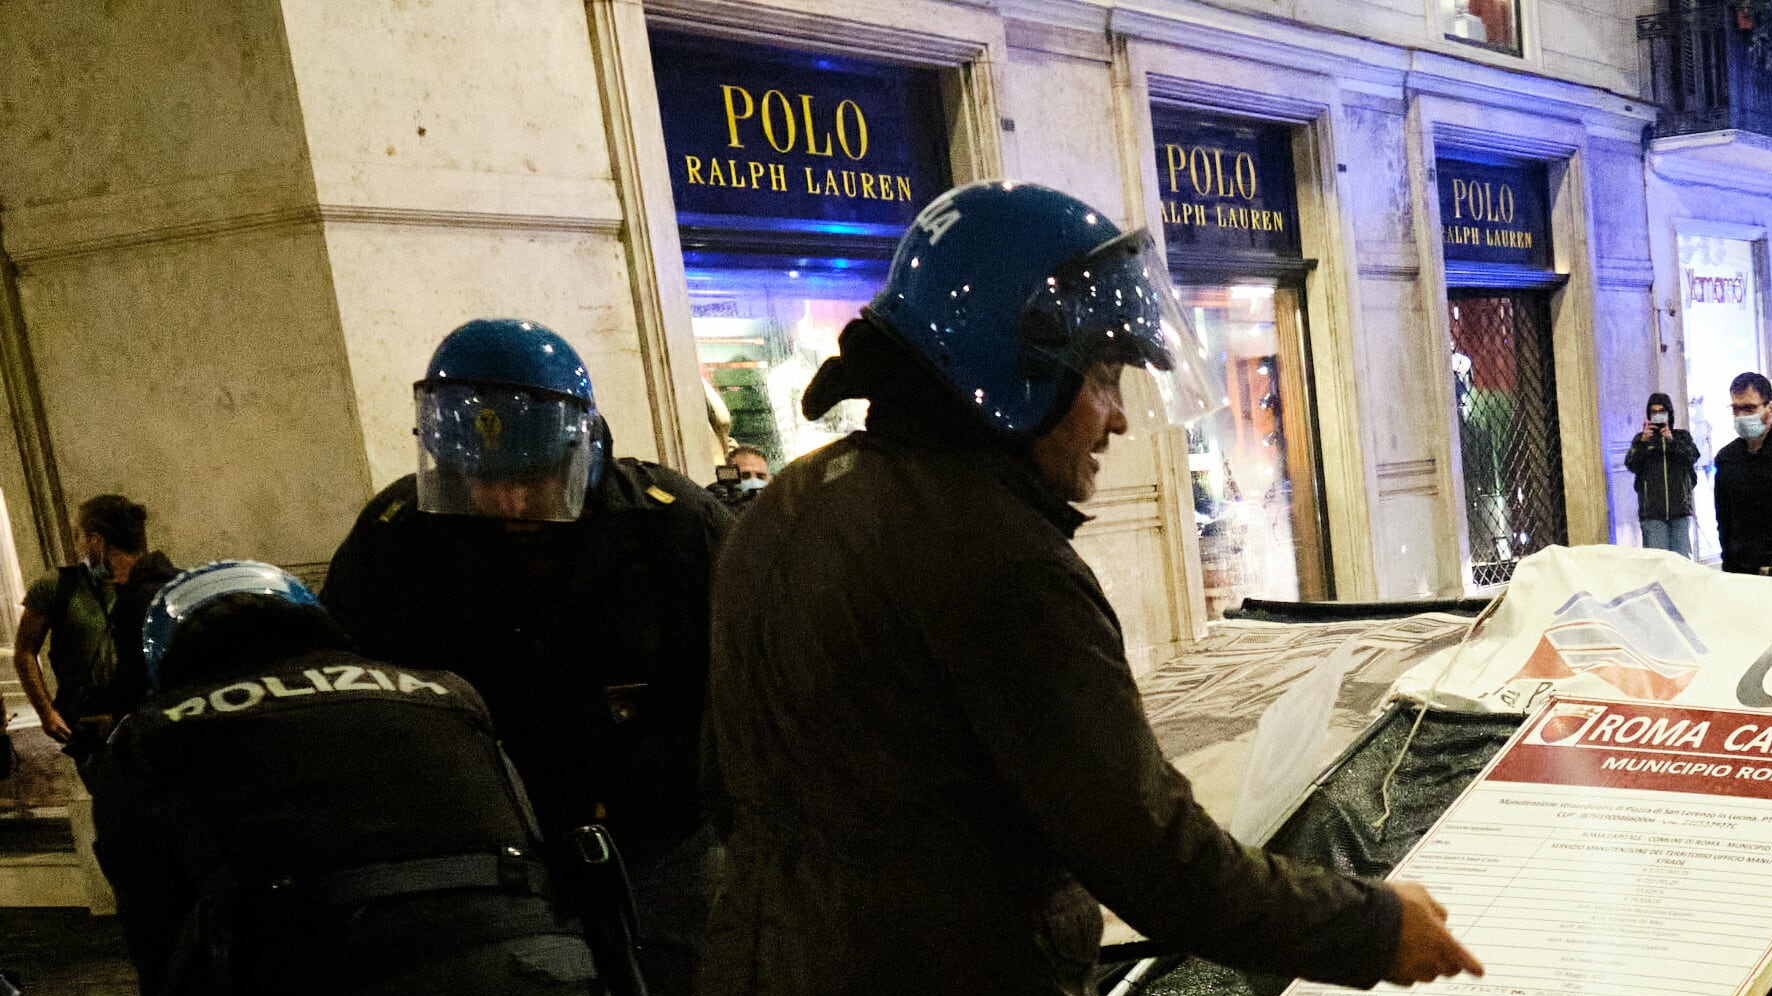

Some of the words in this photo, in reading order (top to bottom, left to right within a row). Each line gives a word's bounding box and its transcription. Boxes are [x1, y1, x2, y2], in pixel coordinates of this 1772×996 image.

[720, 84, 868, 161] POLO
[685, 155, 788, 192] RALPH
[805, 167, 912, 201] LAUREN
[1165, 143, 1256, 200] POLO
[1160, 200, 1206, 227] ALPH
[1216, 206, 1283, 232] LAUREN
[1452, 178, 1514, 224] POLO
[1486, 228, 1532, 249] LAUREN
[163, 666, 449, 722] POLIZIA
[1588, 713, 1710, 749] ROMA
[1601, 756, 1736, 779] MUNICIPIO
[1663, 808, 1680, 816] San
[1681, 810, 1716, 819] Lorenzo
[1696, 839, 1721, 847] ROMA
[1726, 841, 1772, 851] MUNICIPIO
